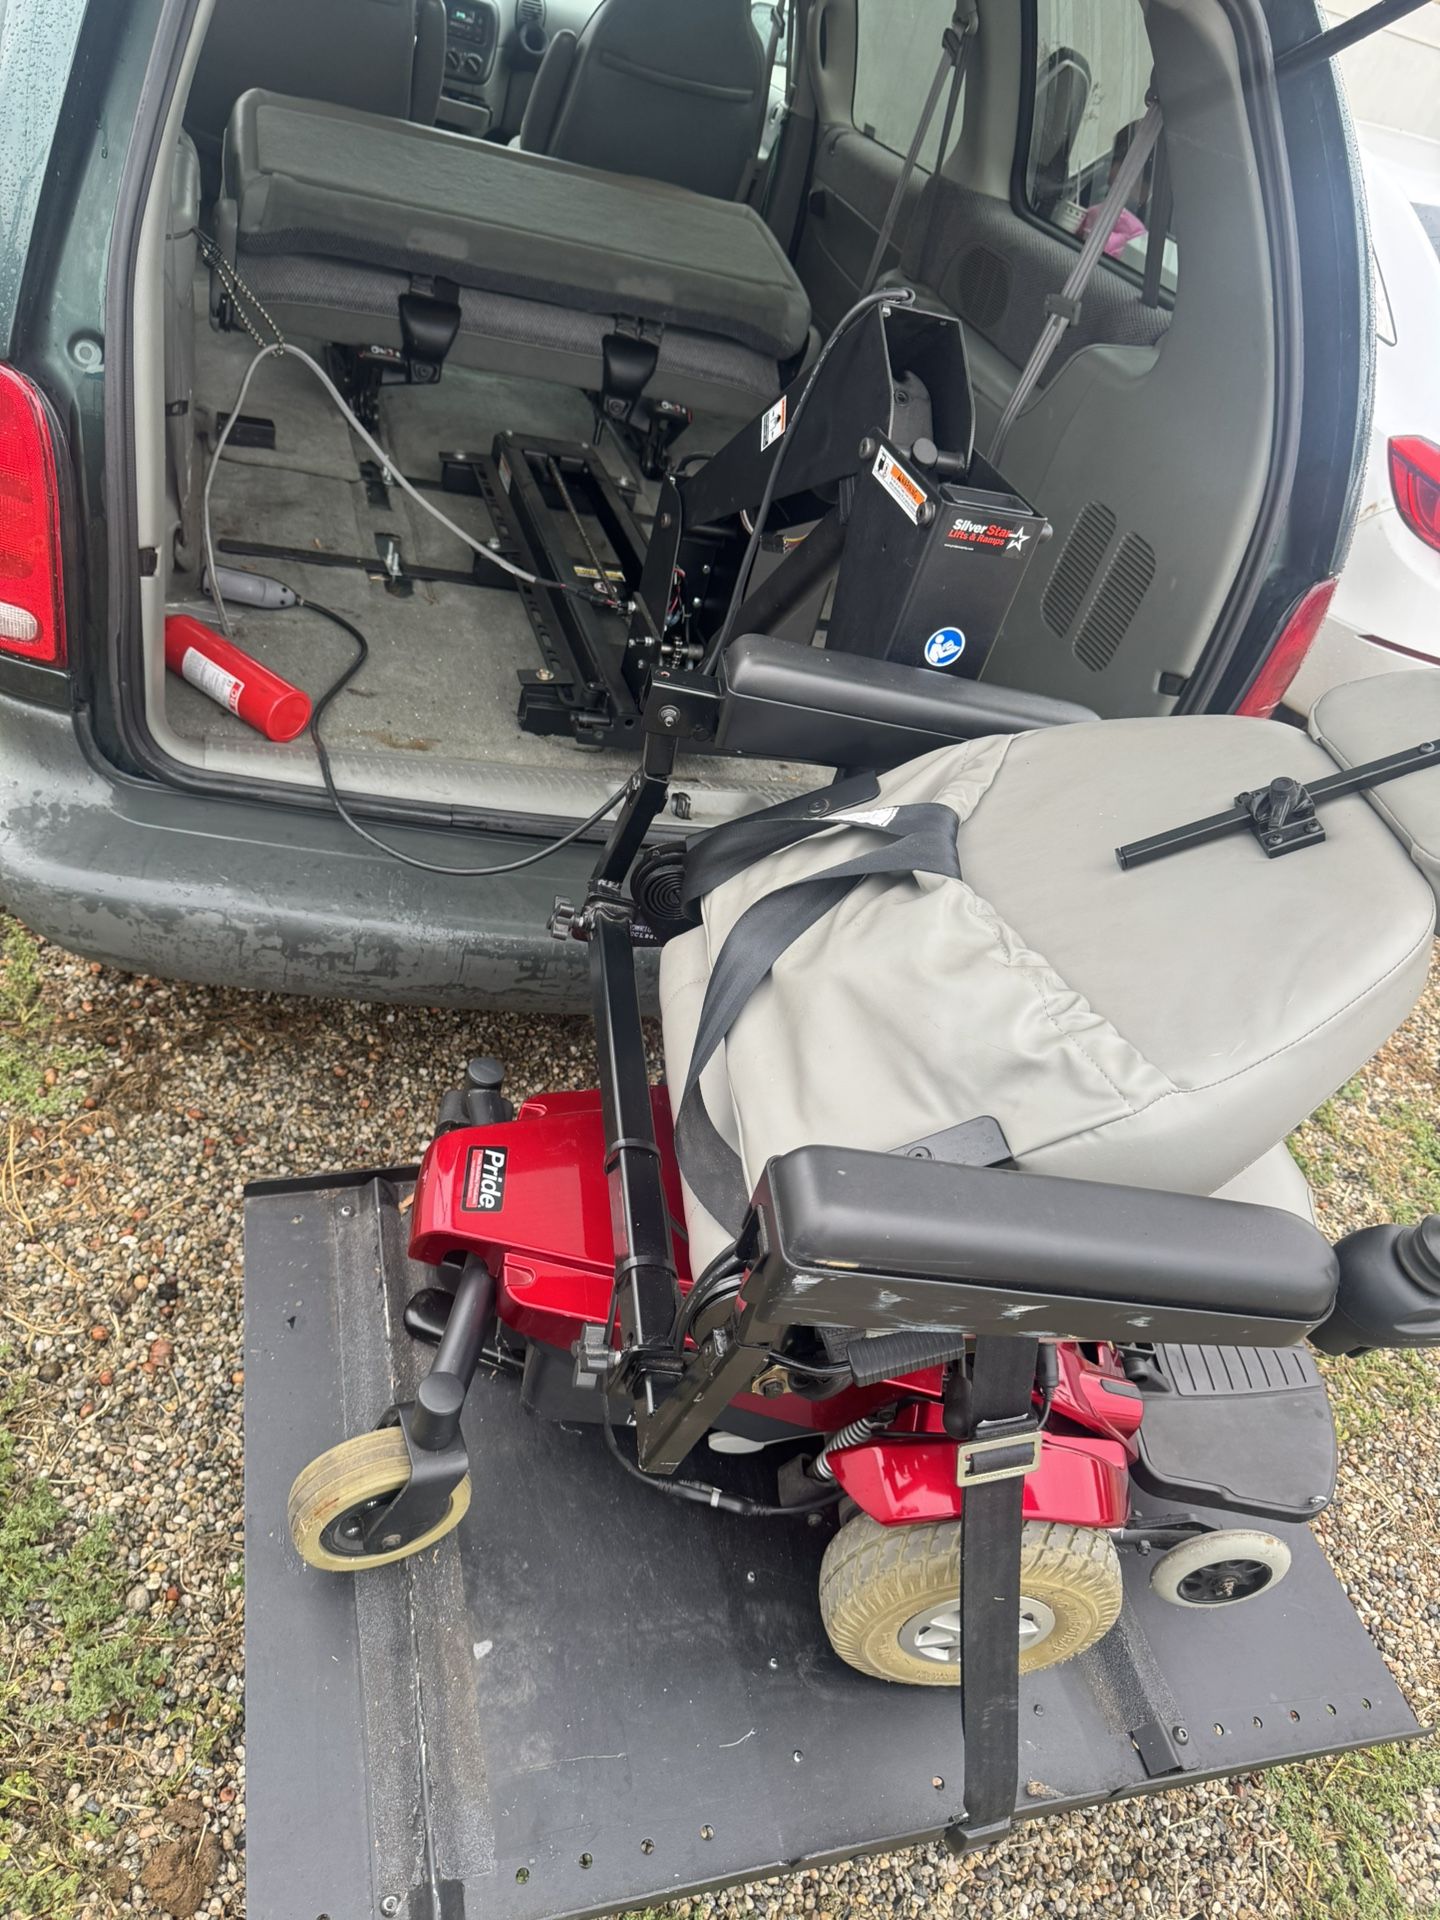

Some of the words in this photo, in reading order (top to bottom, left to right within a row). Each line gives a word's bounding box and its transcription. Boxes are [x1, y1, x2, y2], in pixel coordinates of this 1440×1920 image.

[948, 529, 968, 541] Lifts
[969, 533, 976, 541] &
[977, 534, 1005, 546] Ramps
[952, 519, 988, 534] Silver
[986, 524, 1013, 538] Star
[479, 1149, 505, 1209] Pride
